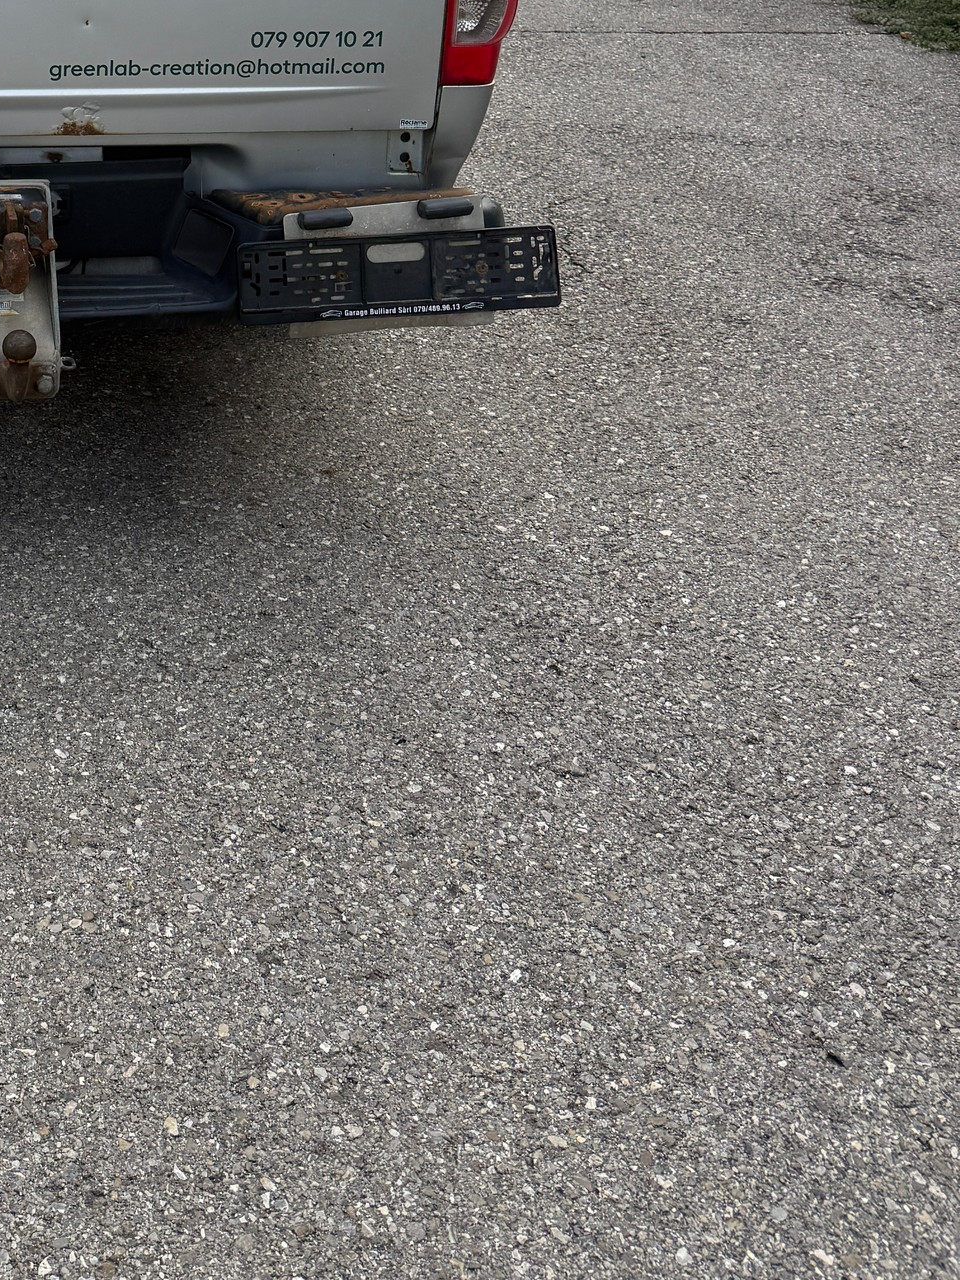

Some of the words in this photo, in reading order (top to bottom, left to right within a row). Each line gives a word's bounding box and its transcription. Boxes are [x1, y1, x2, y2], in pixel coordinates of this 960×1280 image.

[250, 31, 288, 49] 079
[293, 31, 330, 48] 907
[335, 31, 357, 48] 10
[362, 30, 384, 47] 21
[49, 58, 385, 81] greenlab-creation@hotmail.com
[344, 309, 368, 317] Garage
[369, 307, 397, 315] Bulliard
